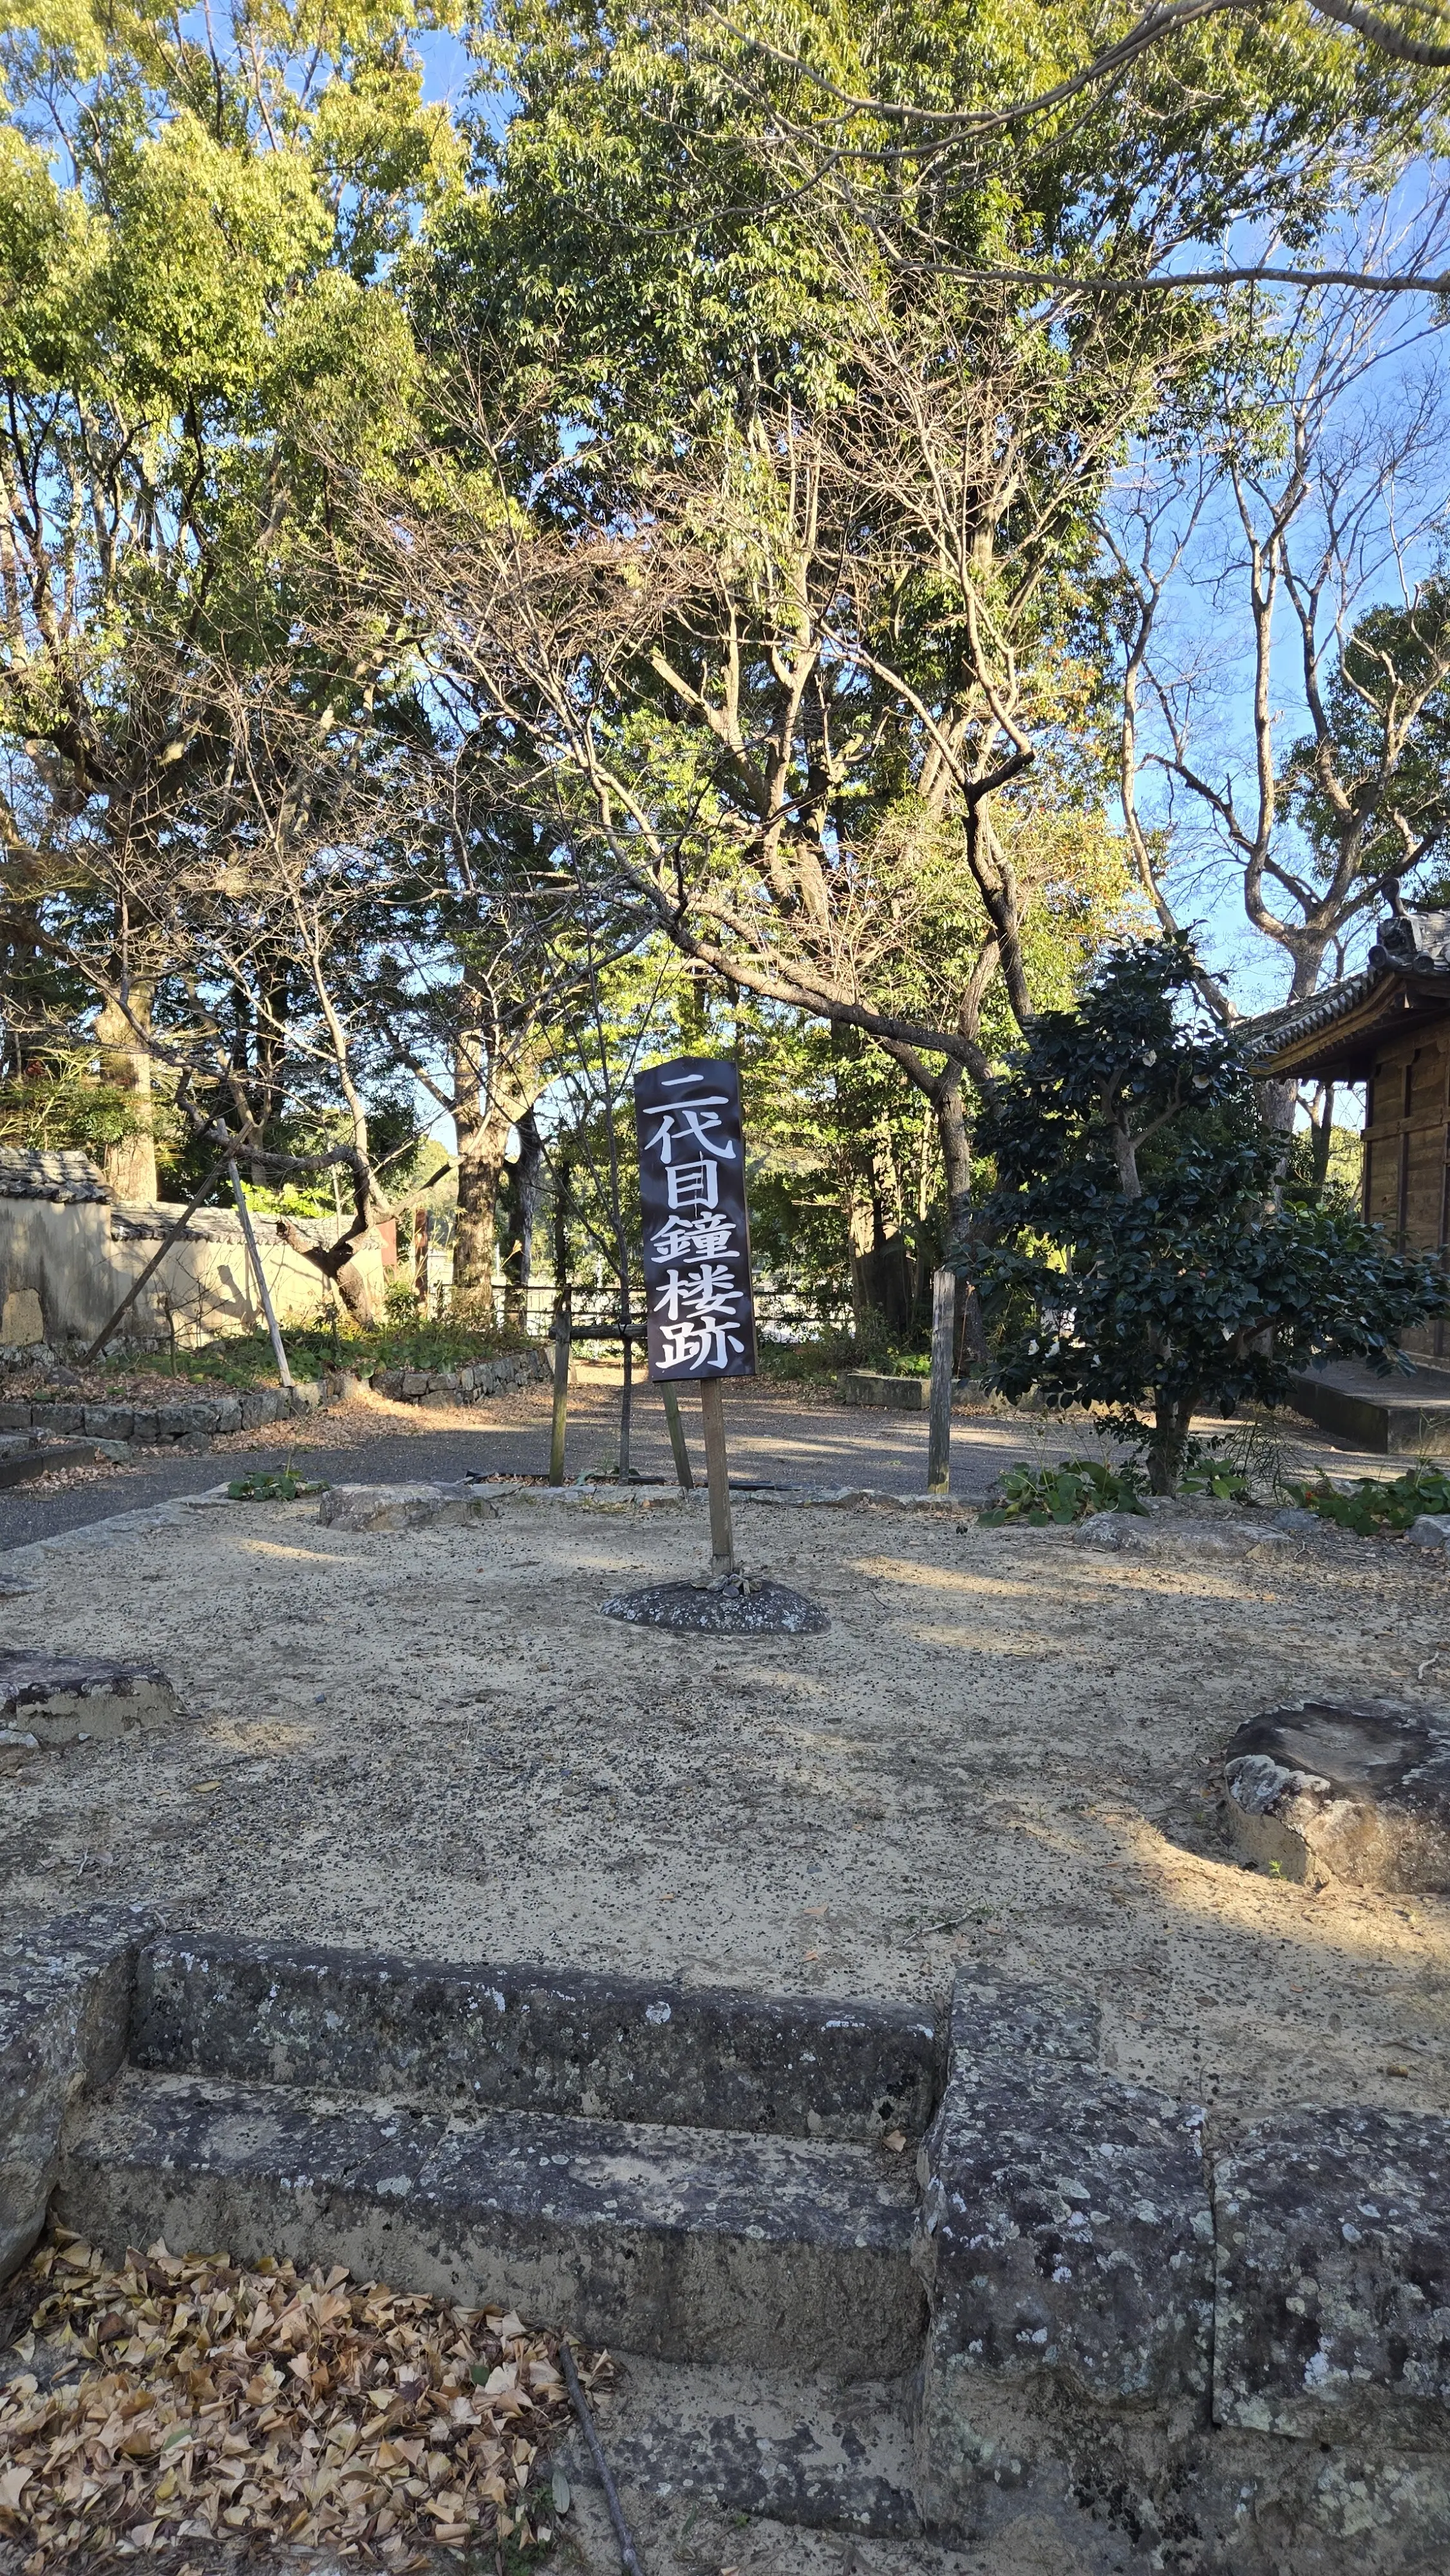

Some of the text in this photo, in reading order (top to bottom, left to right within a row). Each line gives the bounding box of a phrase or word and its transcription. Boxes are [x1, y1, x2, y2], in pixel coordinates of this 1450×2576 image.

[643, 1074, 744, 1371] 二代目鐘楼跡
